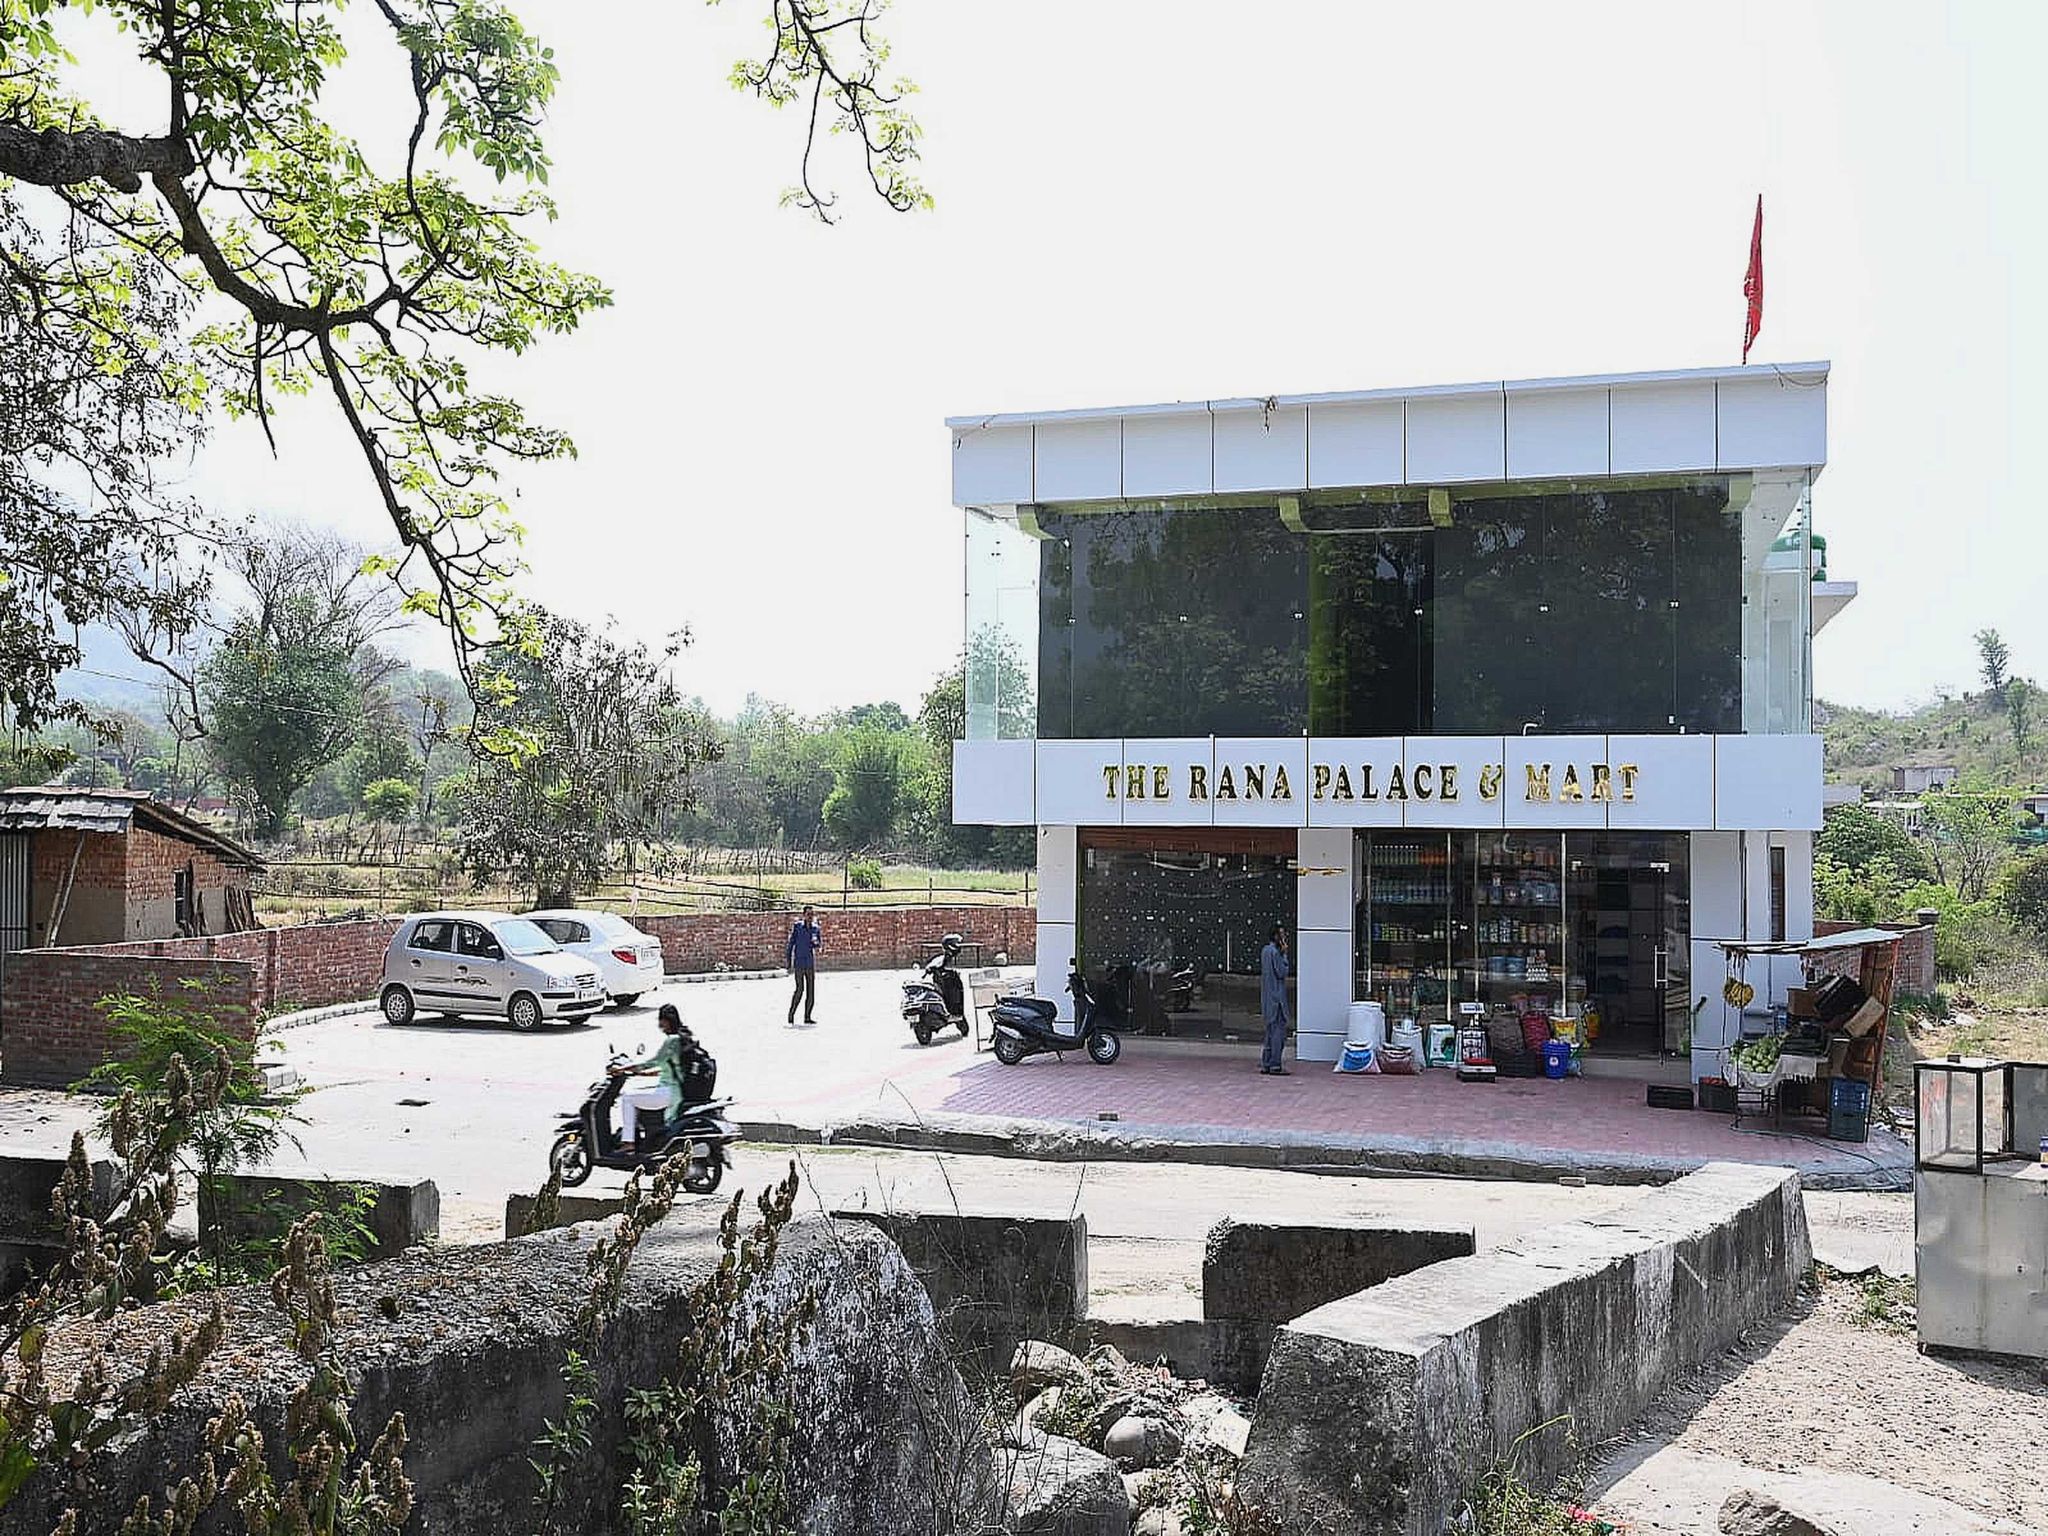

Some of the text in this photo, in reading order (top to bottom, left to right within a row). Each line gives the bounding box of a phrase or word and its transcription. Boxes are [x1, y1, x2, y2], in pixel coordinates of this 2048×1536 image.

[1103, 763, 1639, 800] THE RANA PALACE & MART
